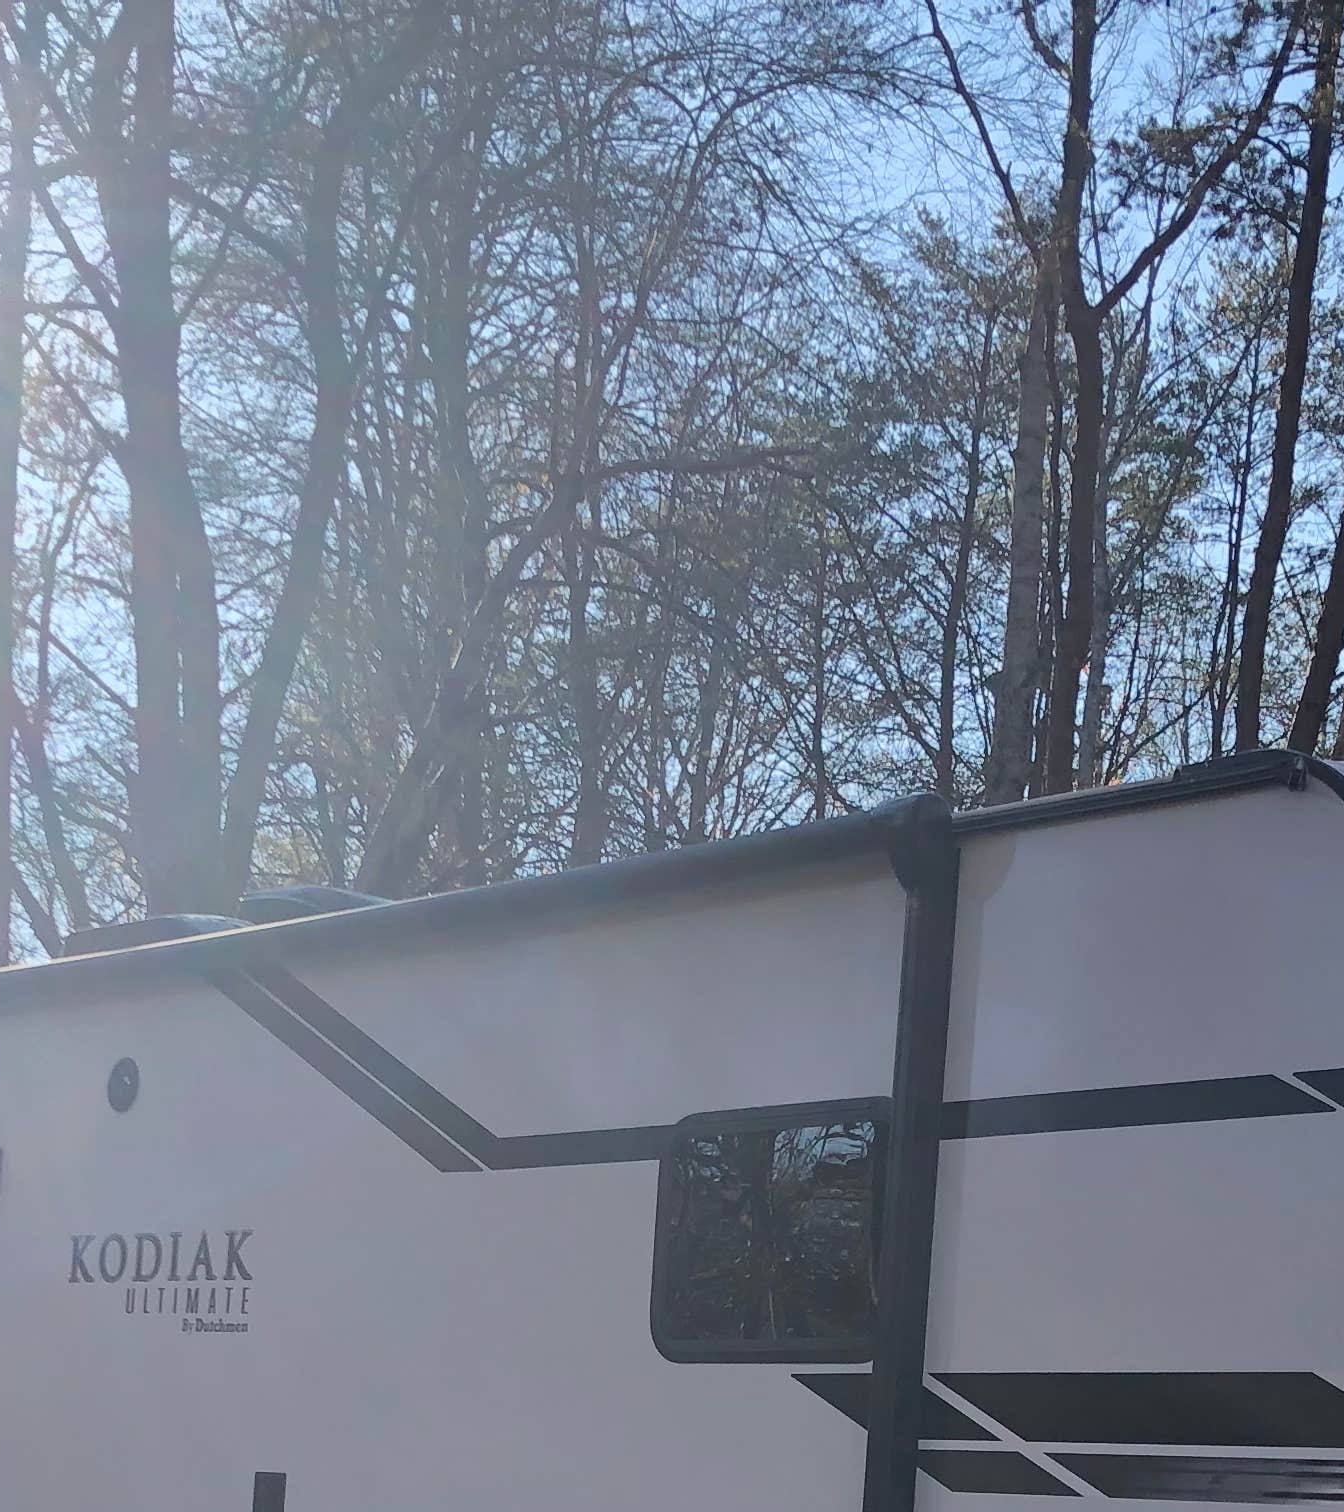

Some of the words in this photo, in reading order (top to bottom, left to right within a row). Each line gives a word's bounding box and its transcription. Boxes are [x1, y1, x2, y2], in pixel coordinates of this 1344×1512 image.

[68, 1229, 255, 1283] KODIAK
[125, 1287, 252, 1314] ULTIMATE
[196, 1318, 249, 1333] Dutchmen
